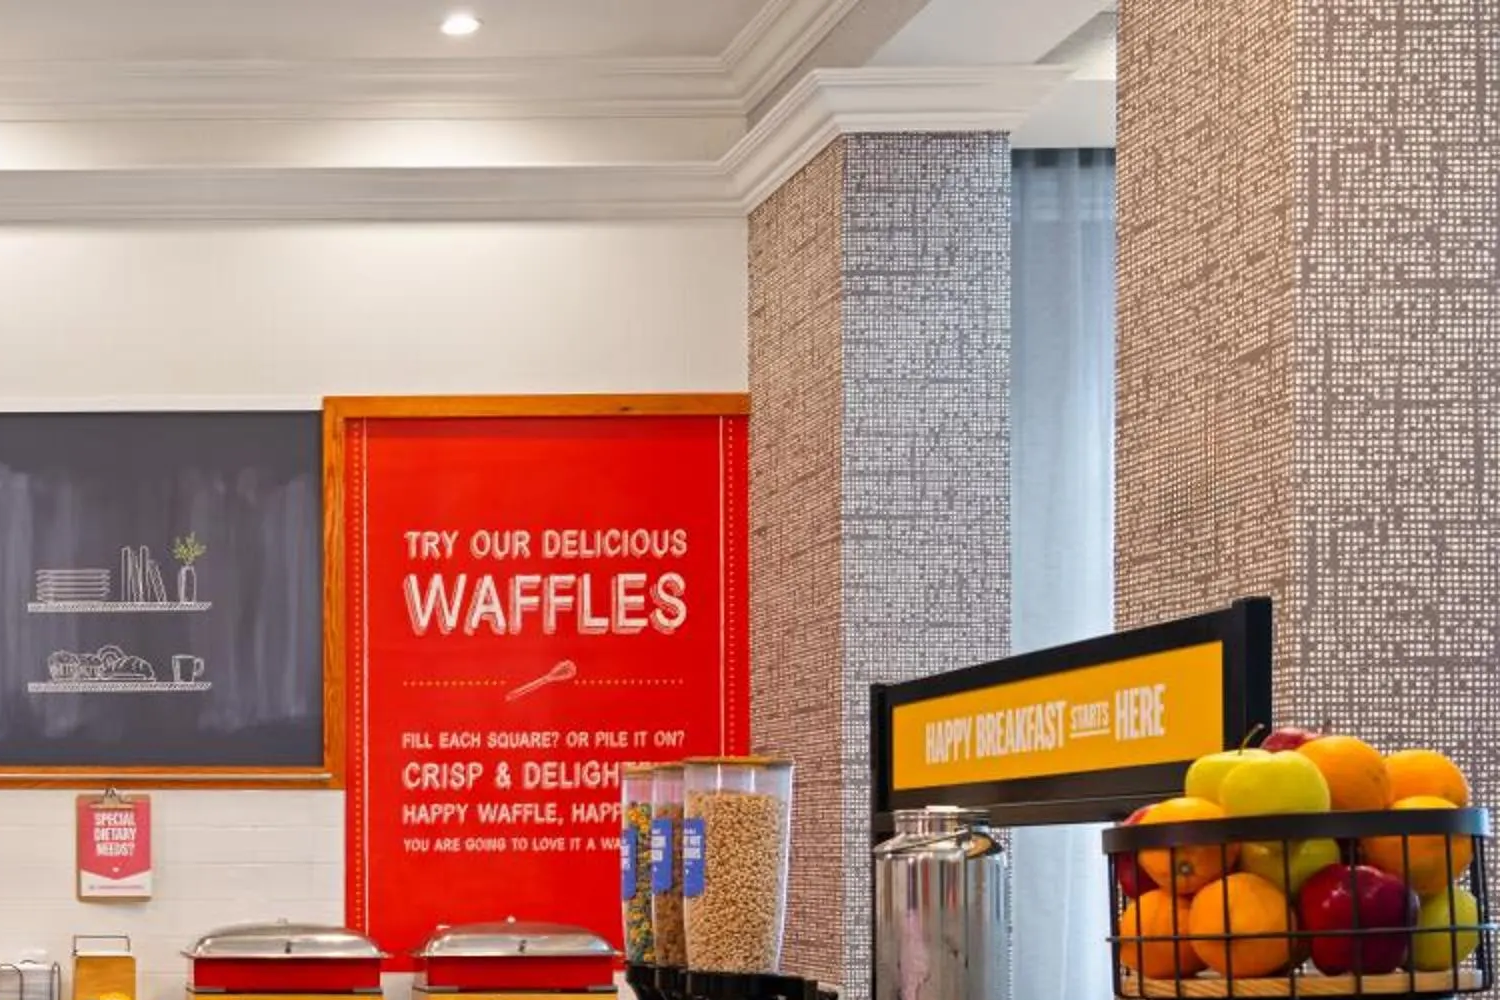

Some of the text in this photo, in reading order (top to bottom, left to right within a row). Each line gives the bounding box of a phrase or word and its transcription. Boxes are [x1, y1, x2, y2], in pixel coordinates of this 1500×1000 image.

[404, 528, 688, 559] TRY OUR DELICIOUS
[404, 572, 688, 635] WAFFLES
[925, 683, 1166, 764] HAPPY BREAKFAST STARTS HERE
[402, 730, 685, 749] FILL EACH SQUARE? OR PILE IT ON?
[402, 760, 620, 789] CRISP & DELIGH
[402, 802, 622, 826] HAPPY WAFFLE, HAPP
[403, 837, 620, 852] YOU ARE GOING TO LOVE IT A WA
